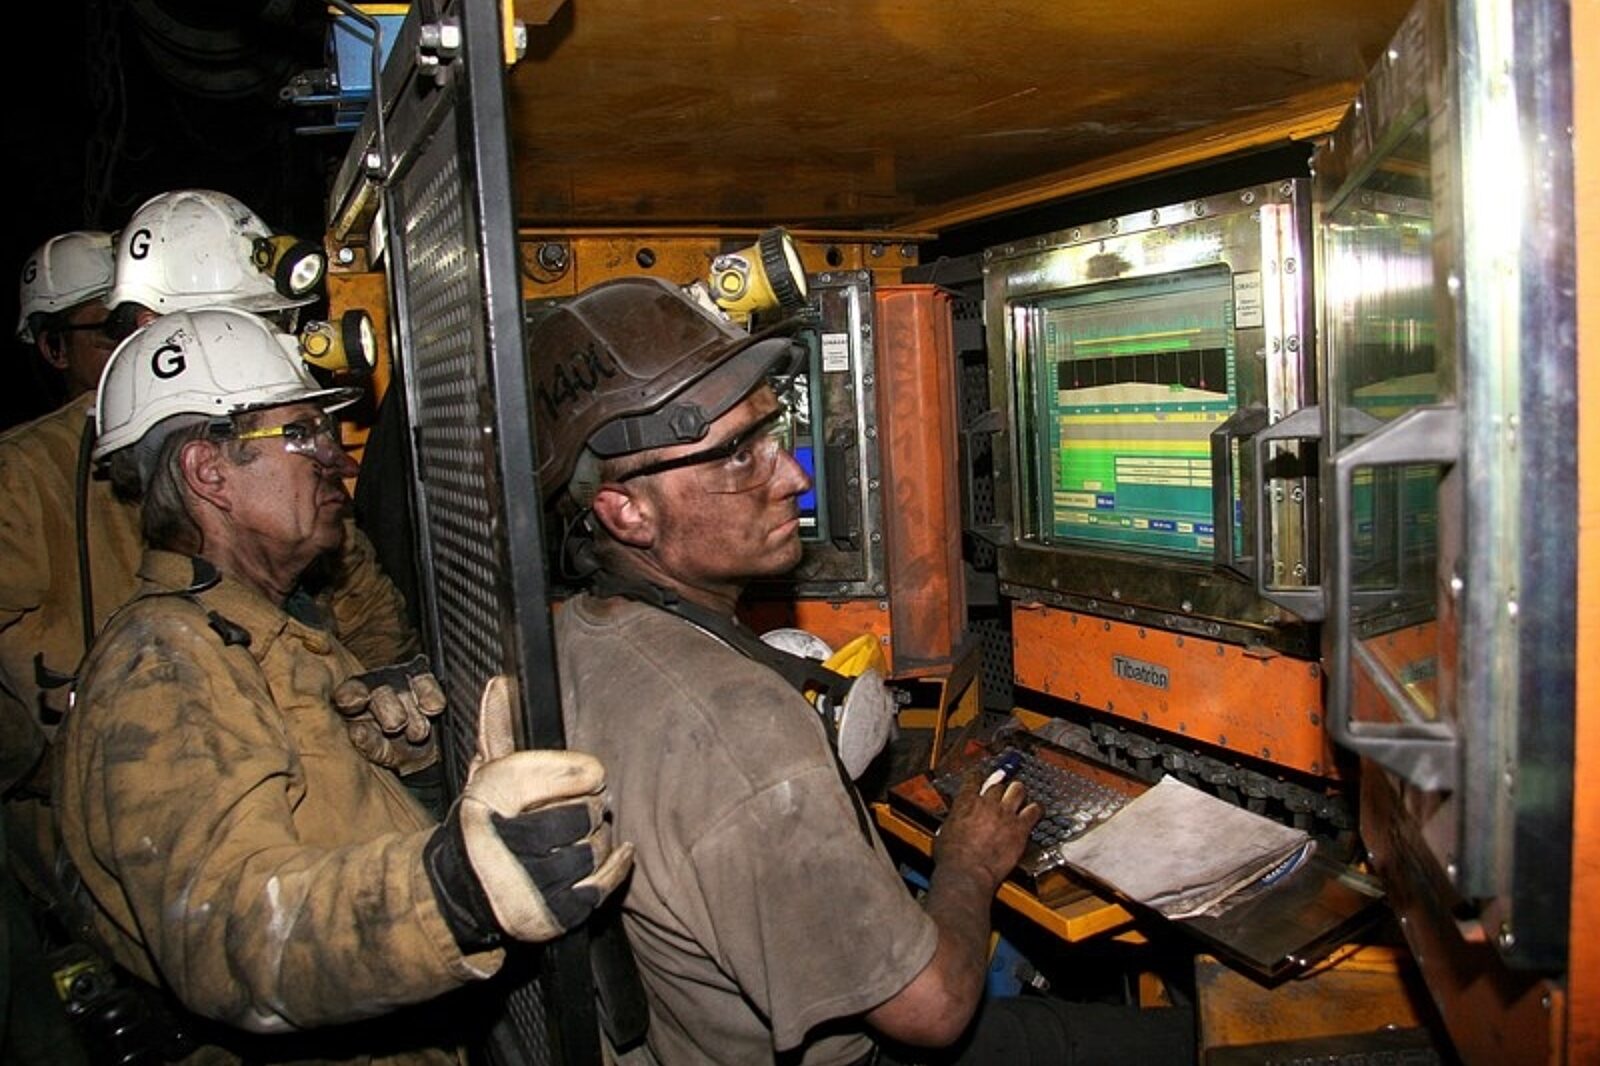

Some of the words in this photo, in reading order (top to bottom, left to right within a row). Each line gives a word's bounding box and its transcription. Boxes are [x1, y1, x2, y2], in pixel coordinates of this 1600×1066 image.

[130, 229, 151, 260] G
[23, 260, 37, 284] G
[152, 345, 187, 379] G
[1114, 657, 1168, 689] Tibatron
